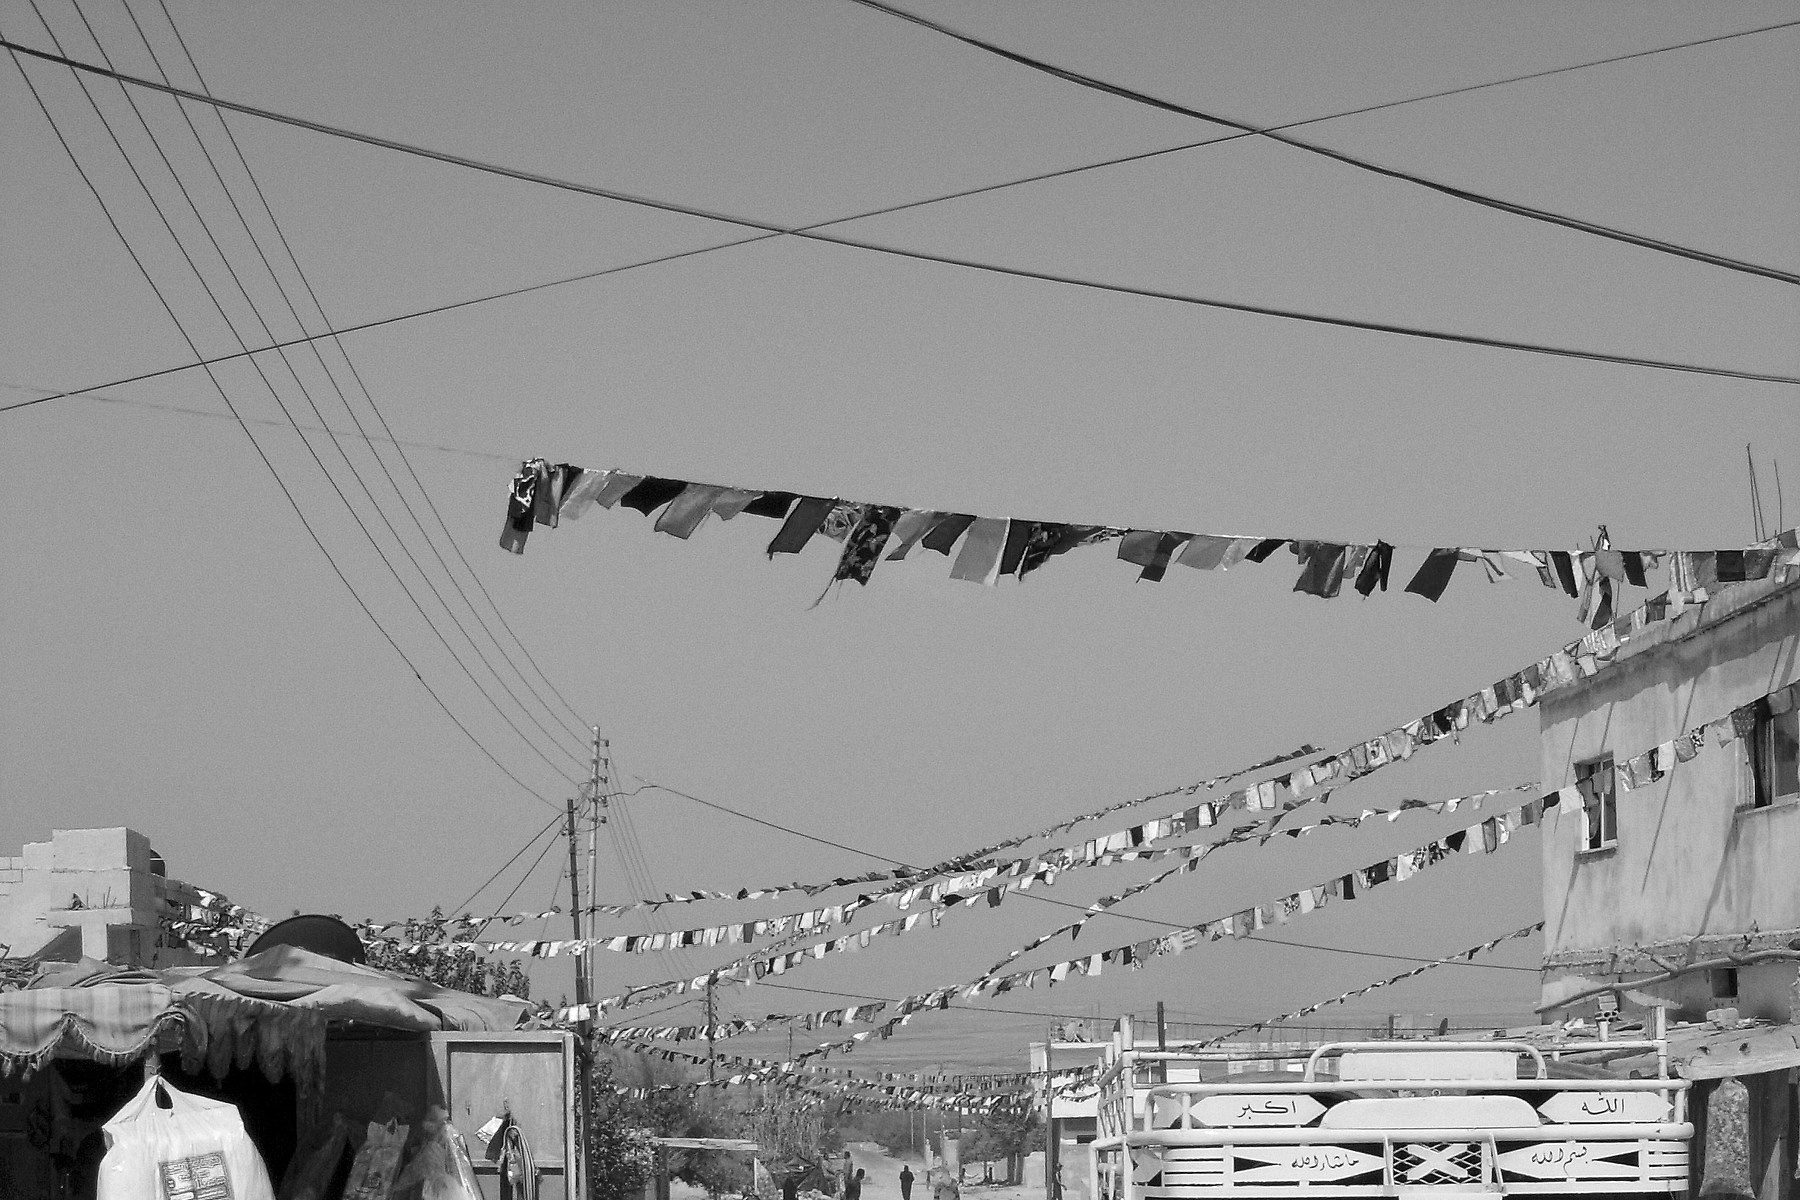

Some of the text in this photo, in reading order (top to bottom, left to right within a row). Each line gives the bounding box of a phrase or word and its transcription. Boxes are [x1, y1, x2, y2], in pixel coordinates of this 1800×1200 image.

[1237, 1091, 1625, 1120] الله اكبر
[1531, 1145, 1588, 1176] بسم الله
